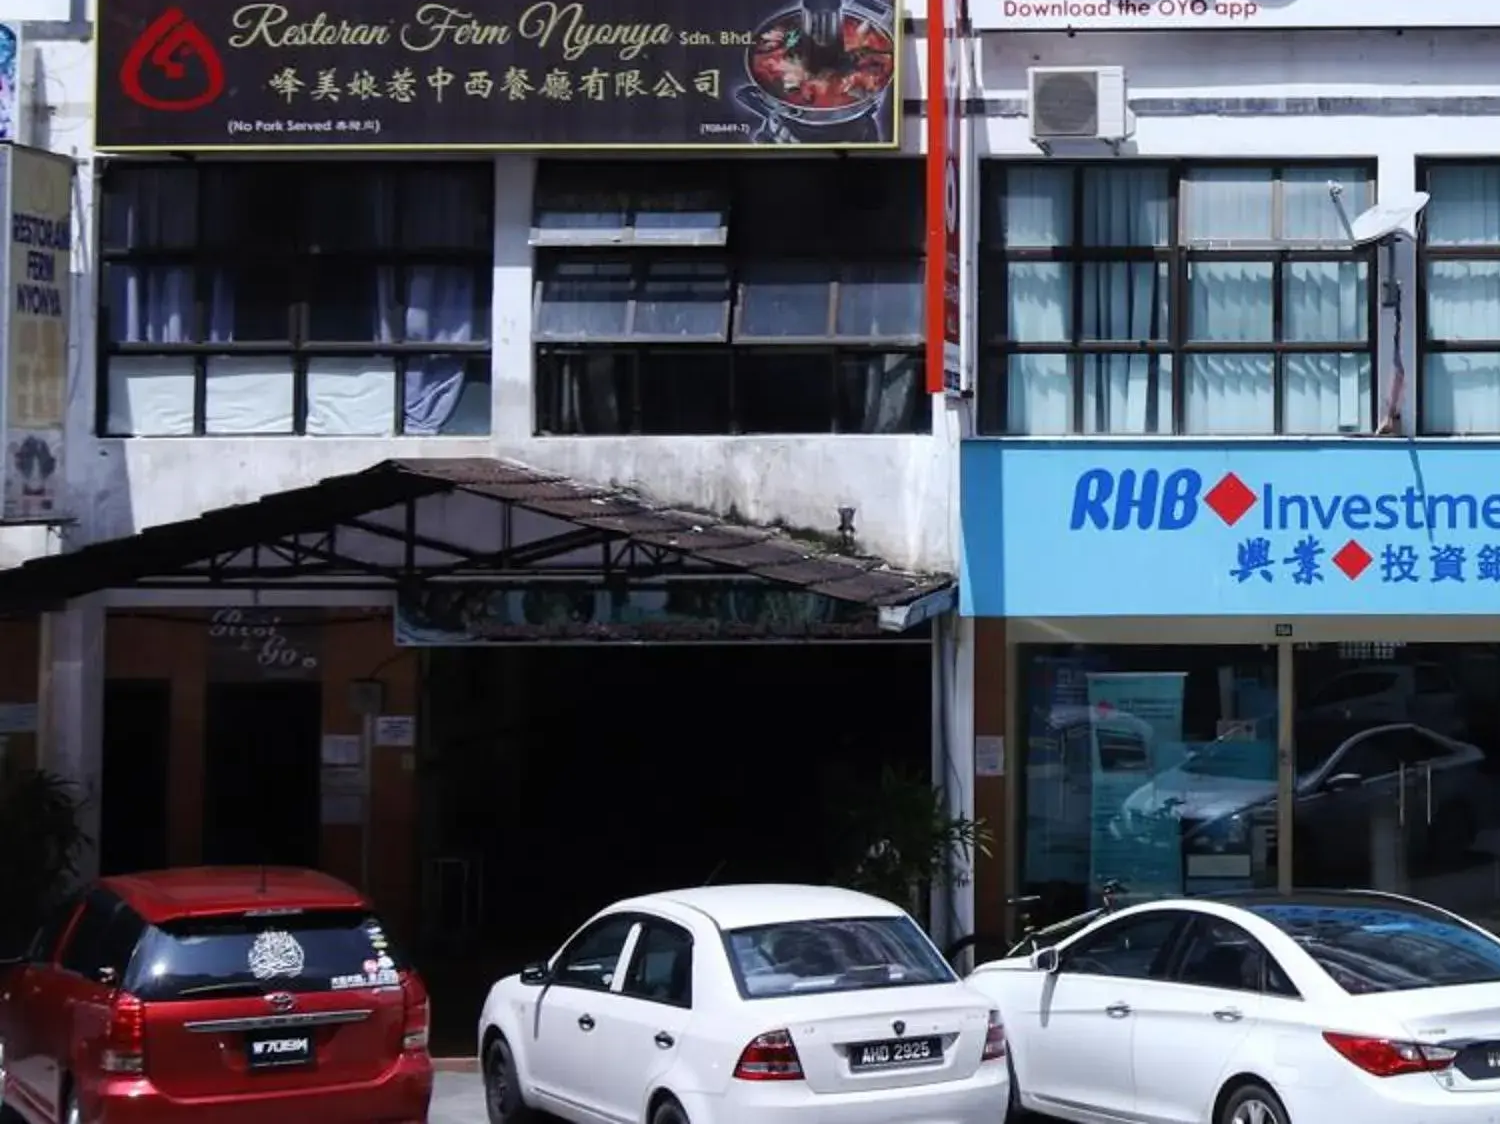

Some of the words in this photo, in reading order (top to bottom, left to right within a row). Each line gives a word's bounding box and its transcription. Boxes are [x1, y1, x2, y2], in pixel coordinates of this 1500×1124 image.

[1004, 0, 1113, 17] Download
[1117, 0, 1150, 16] the
[1158, 0, 1208, 16] OYO
[1215, 1, 1257, 18] app
[228, 3, 391, 49] Restoran
[400, 3, 513, 52] Ferm
[519, 1, 673, 61] Nyonya
[679, 30, 715, 46] Sdn.
[720, 30, 756, 46] Bhd.
[255, 119, 283, 132] Pork
[287, 119, 332, 132] Served
[17, 283, 62, 317] NYONYA
[1070, 468, 1203, 531] RHB
[862, 1045, 889, 1064] AHD
[894, 1041, 930, 1060] 2925
